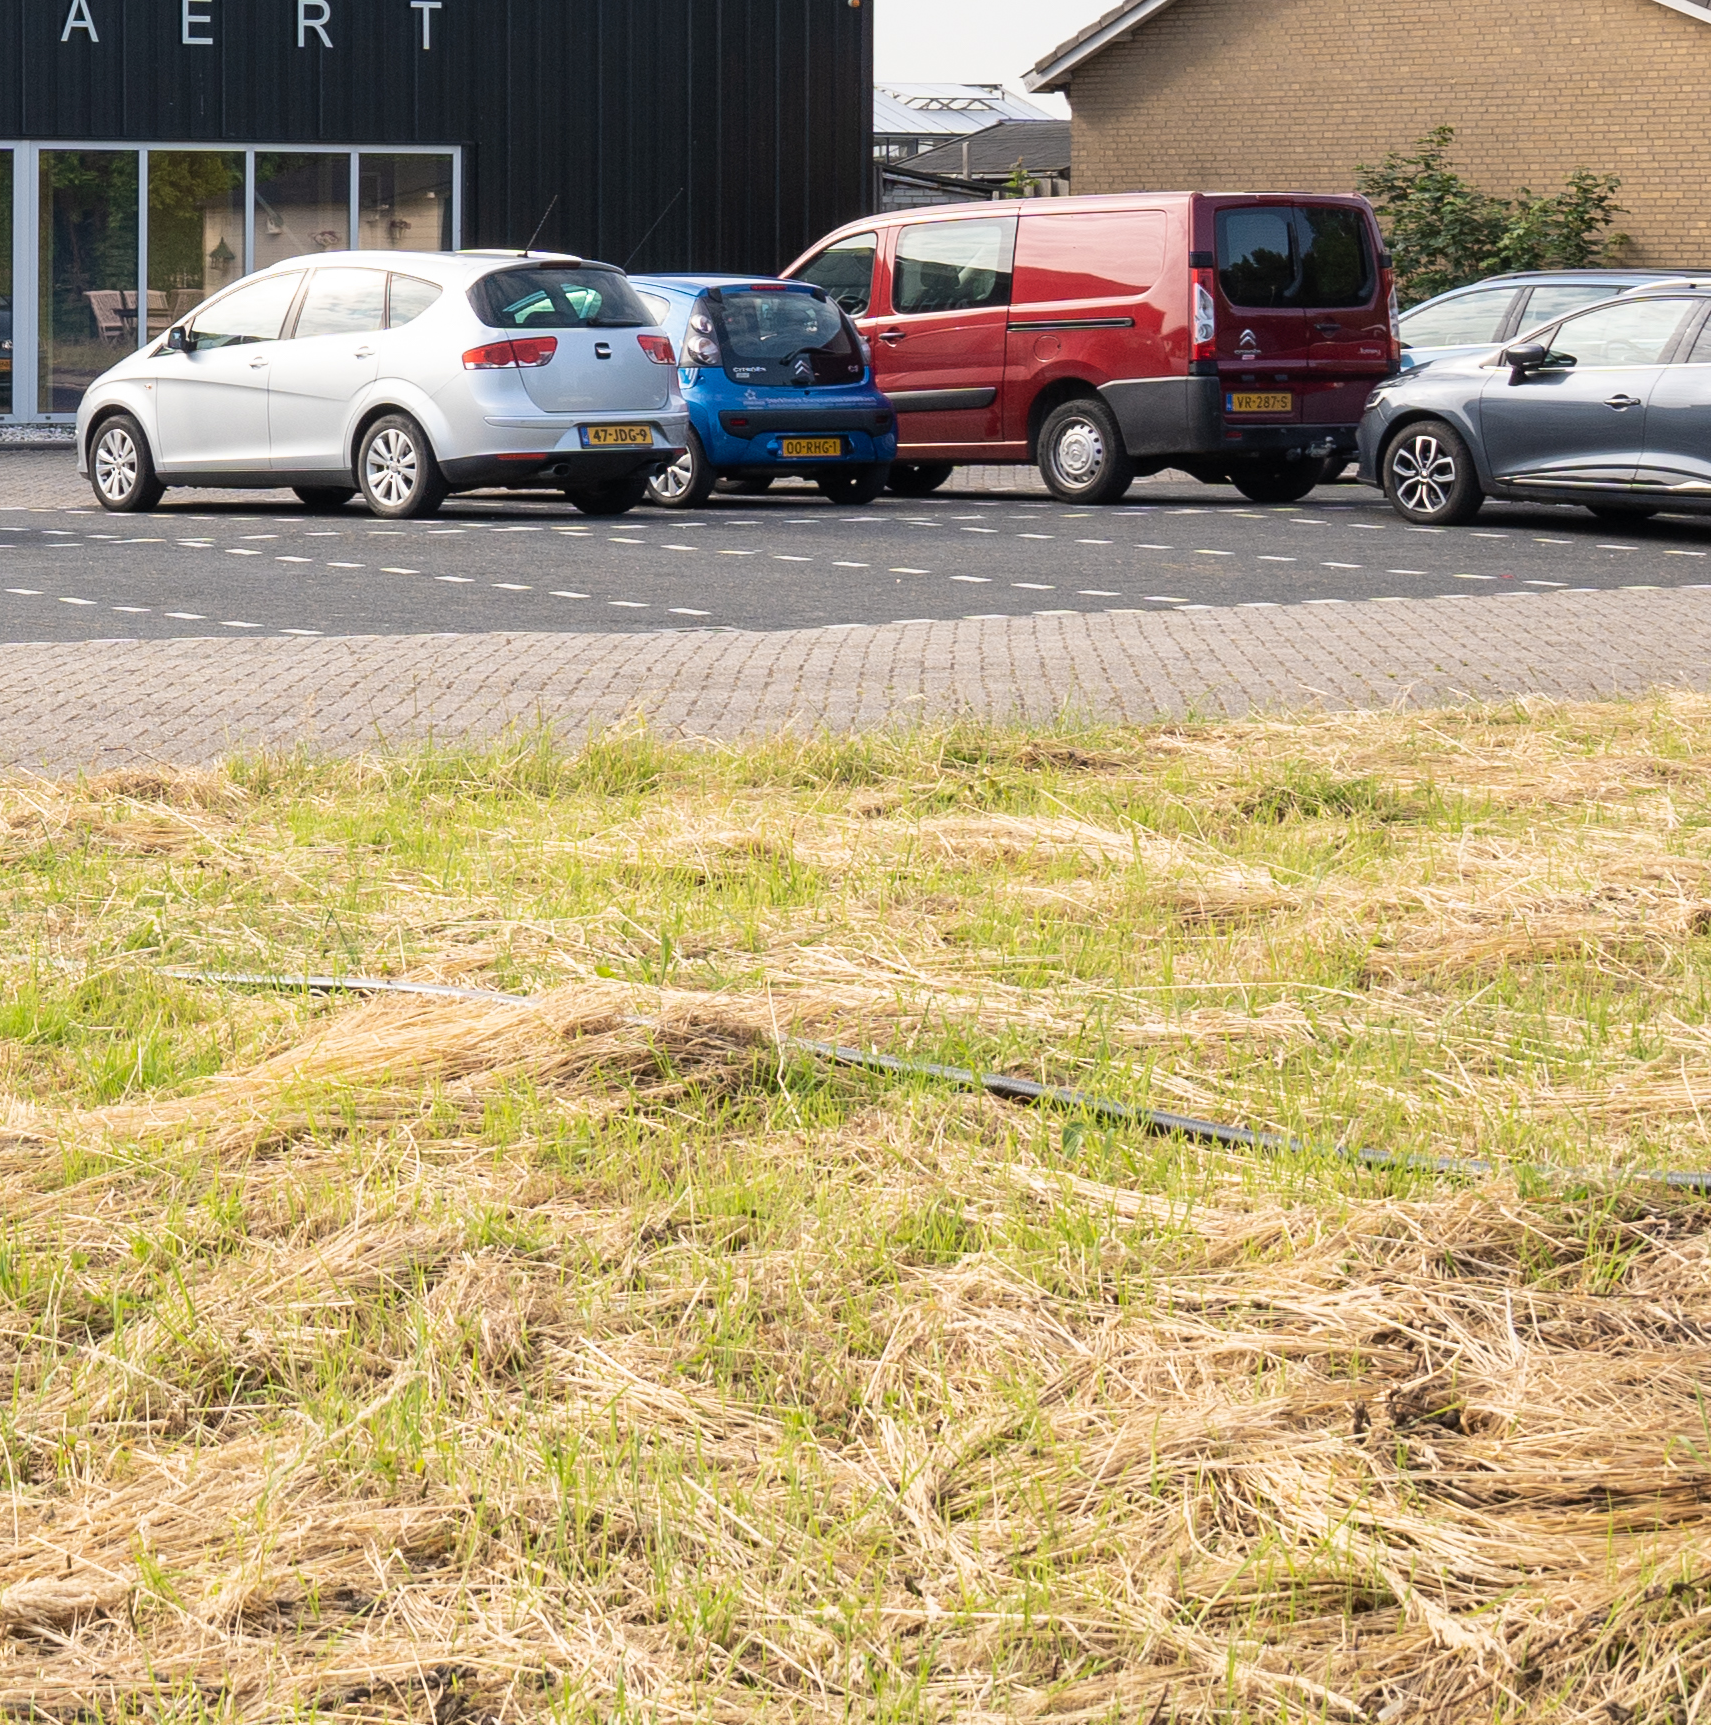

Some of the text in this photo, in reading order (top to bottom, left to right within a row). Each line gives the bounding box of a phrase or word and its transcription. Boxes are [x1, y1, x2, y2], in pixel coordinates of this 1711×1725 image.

[1237, 395, 1288, 409] VR-287-S
[593, 428, 648, 442] 47-JDG-9
[786, 440, 837, 455] 00-RHG-1
